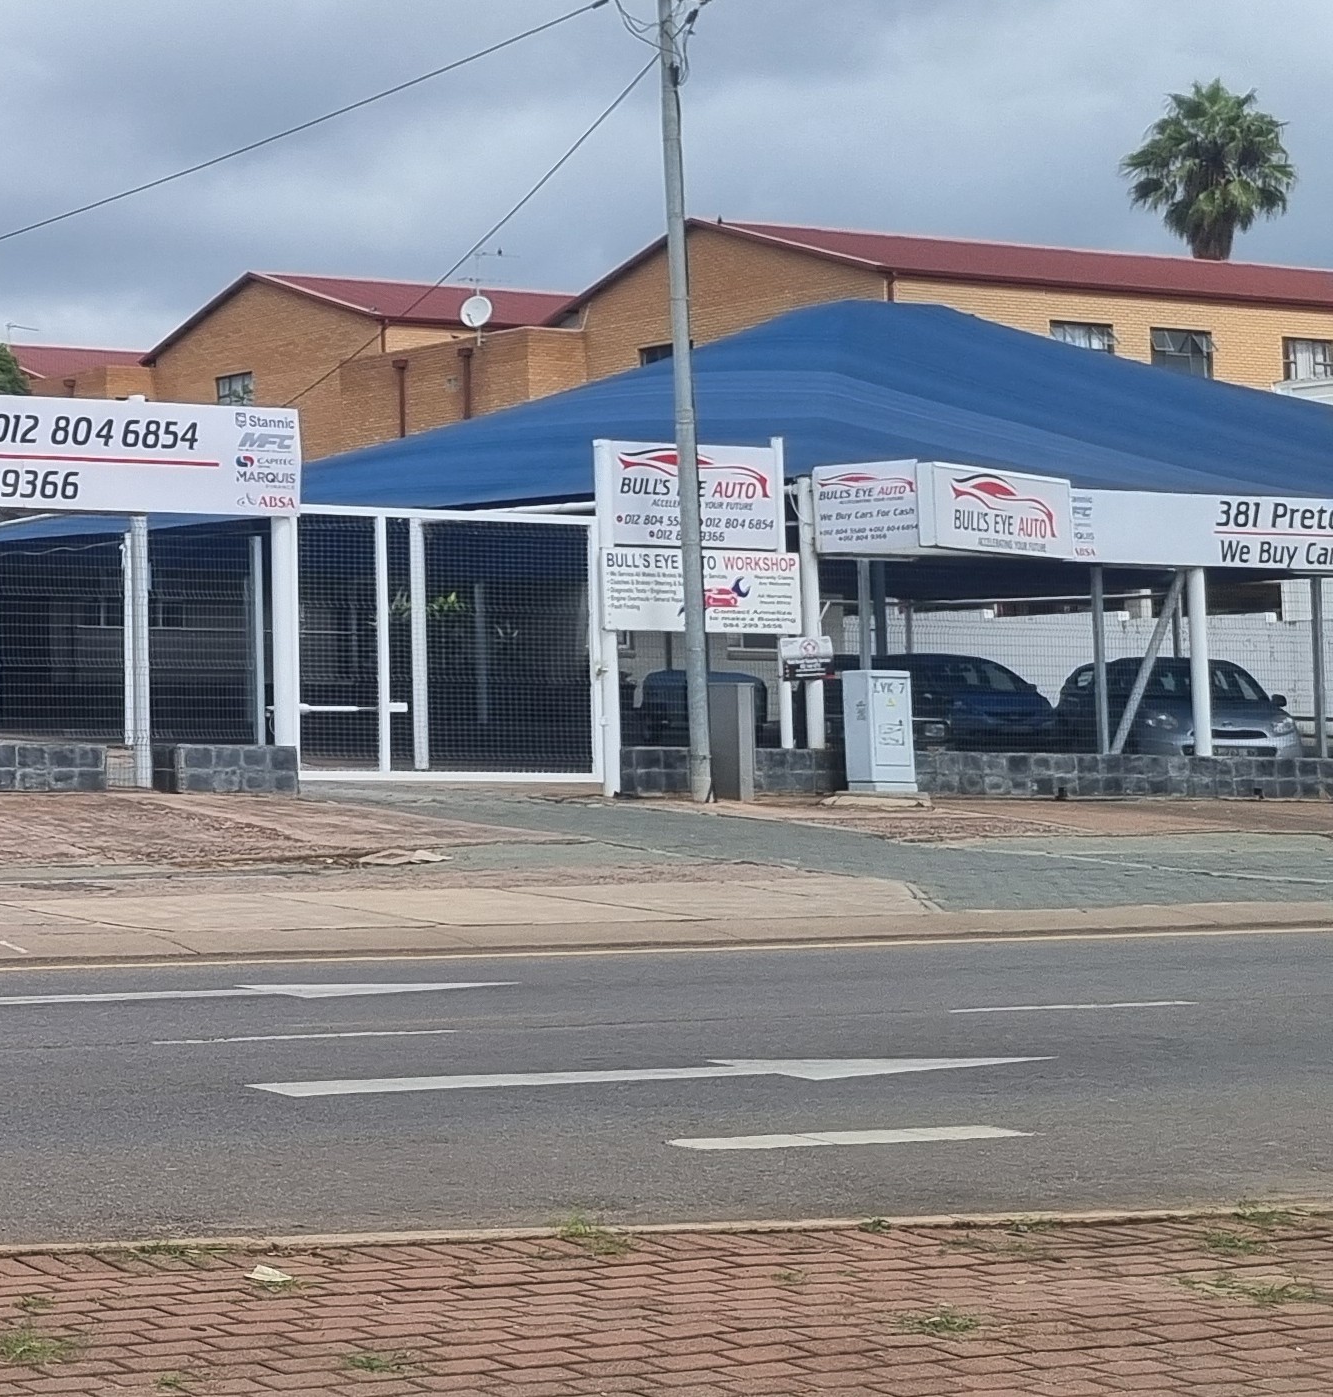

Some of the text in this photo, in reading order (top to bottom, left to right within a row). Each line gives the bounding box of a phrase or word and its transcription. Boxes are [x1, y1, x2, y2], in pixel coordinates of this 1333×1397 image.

[249, 414, 295, 429] Stannic
[50, 416, 114, 447] 804
[121, 419, 199, 450] 6854
[238, 432, 295, 450] MFC
[0, 469, 80, 500] 9366
[236, 470, 296, 484] MARQUIS
[620, 477, 670, 496] BULL'S
[712, 481, 756, 499] AUTO
[877, 485, 907, 496] AUTO
[258, 495, 295, 508] ABSA
[705, 517, 722, 528] 012
[725, 518, 745, 529] 804
[1215, 500, 1261, 528] 381
[954, 509, 1047, 539] BULL'S EYE AUTO
[606, 553, 650, 568] BULL'S
[654, 554, 679, 569] EYE
[723, 556, 796, 572] WORKSHOP
[1220, 540, 1251, 564] We
[1258, 541, 1299, 568] Buy
